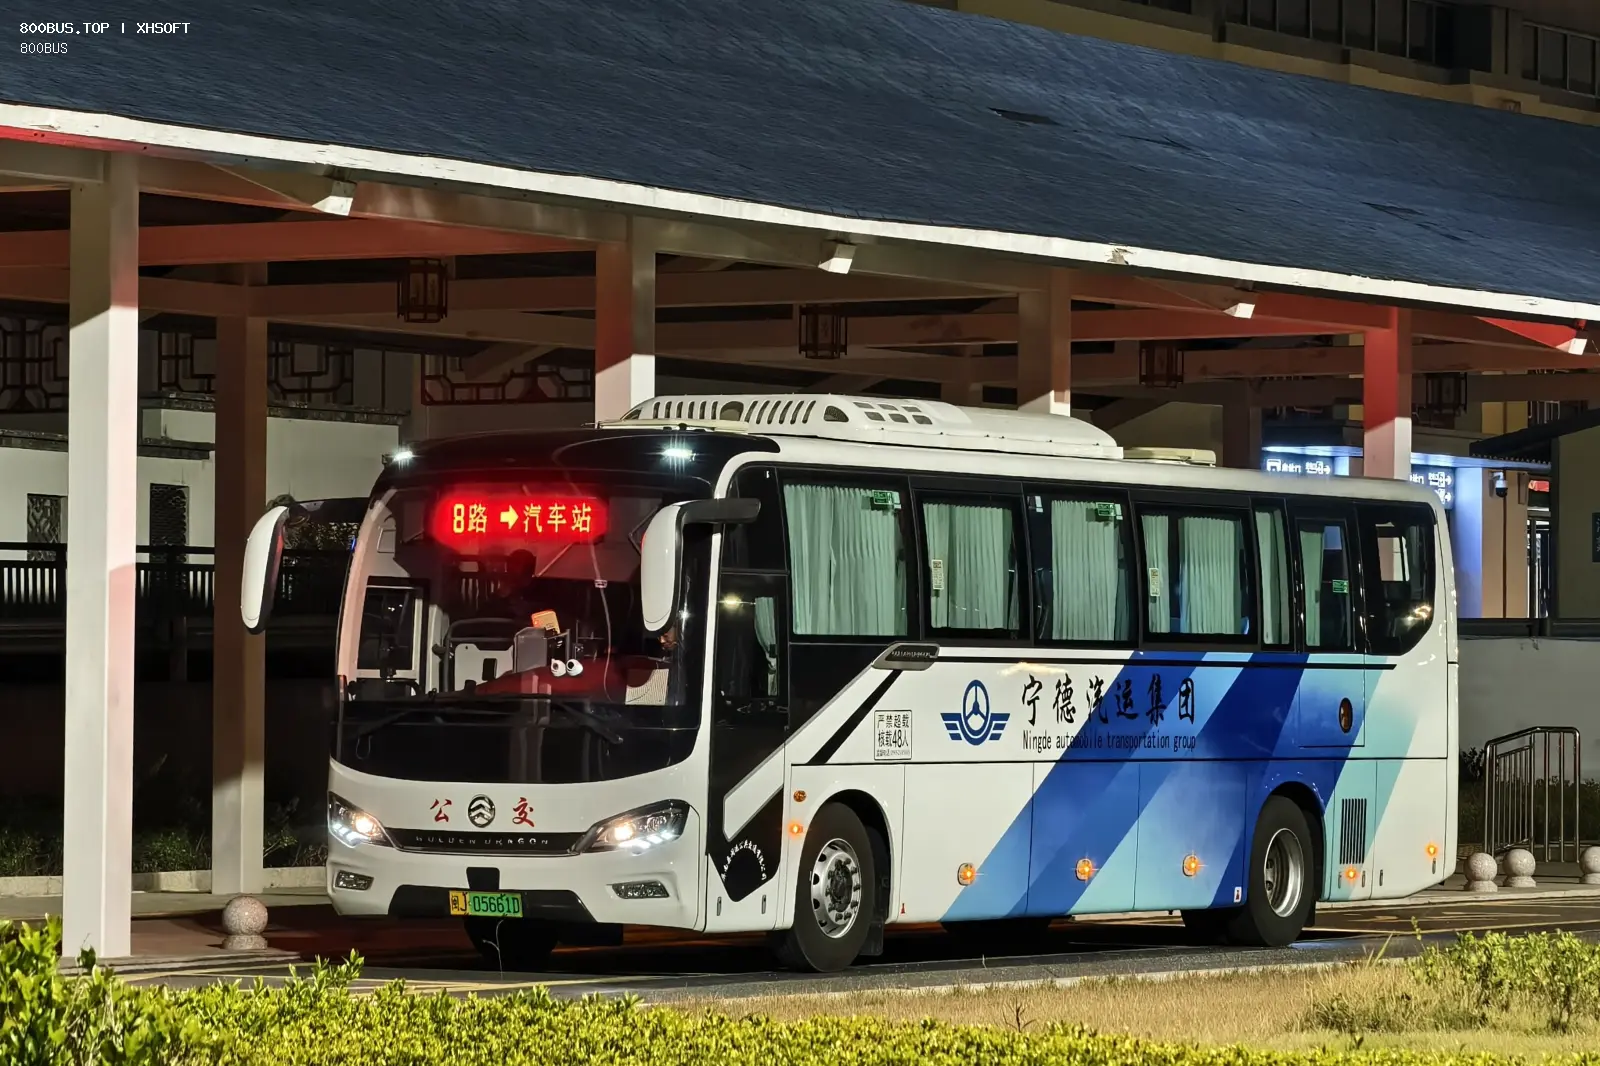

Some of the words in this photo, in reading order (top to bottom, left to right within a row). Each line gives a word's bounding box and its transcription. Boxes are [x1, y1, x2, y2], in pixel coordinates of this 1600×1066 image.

[453, 503, 488, 533] 8路
[523, 503, 592, 533] 汽车站
[1022, 673, 1195, 727] 宁德汽运集团
[877, 714, 910, 729] 严禁超载
[877, 729, 909, 748] 核载48人
[1022, 730, 1052, 753] Ningde
[1056, 731, 1101, 750] automobile
[1107, 731, 1170, 752] transportation
[1173, 735, 1197, 753] group
